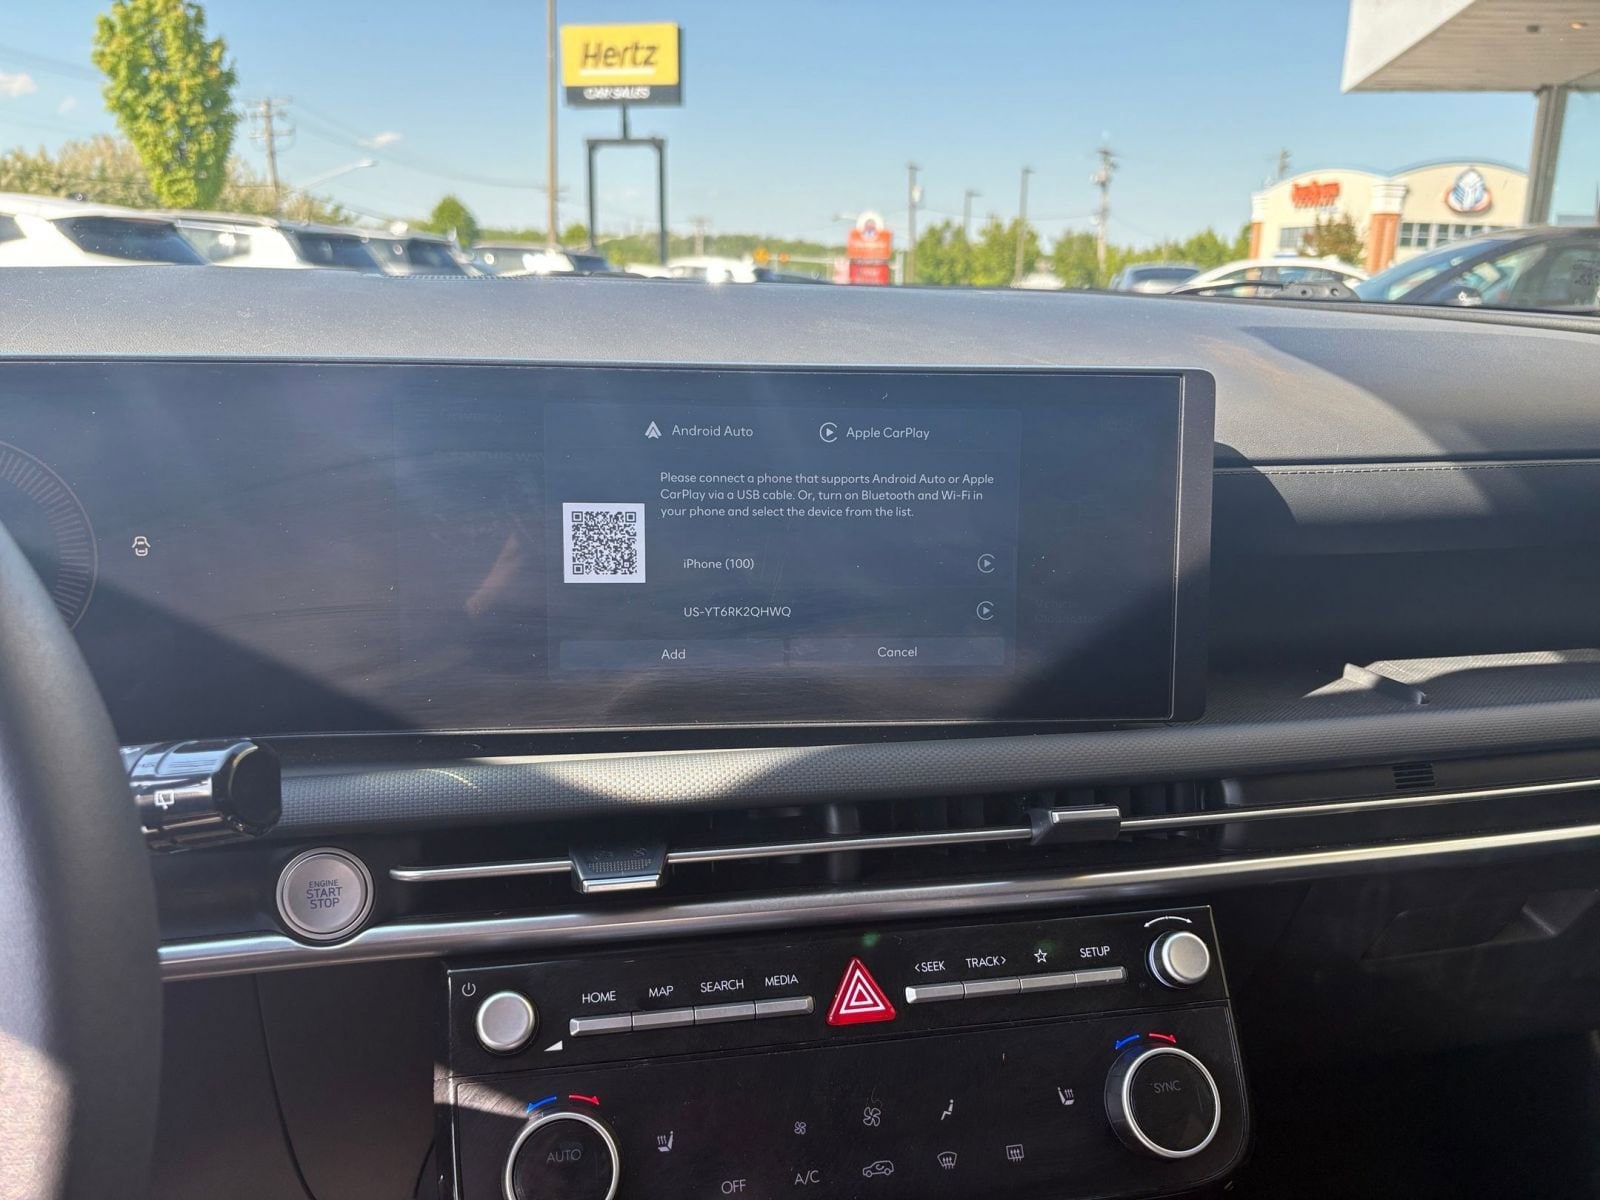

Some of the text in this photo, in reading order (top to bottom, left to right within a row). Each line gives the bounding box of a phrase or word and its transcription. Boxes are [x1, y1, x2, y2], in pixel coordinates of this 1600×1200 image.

[580, 41, 658, 68] Hertz
[671, 424, 753, 437] Android Auto
[846, 427, 931, 440] Apple CarPlay
[660, 472, 994, 486] Please connect a phone that supports Android Auto or Apple
[660, 489, 983, 501] CarPlay via a USB cable. Or, turn on Bluetooth and Wi-Fi in
[660, 506, 914, 518] your phone and select the device from the list.
[683, 558, 754, 570] iPhone (100)
[684, 606, 792, 617] US-YT6RK2QHWQ
[661, 649, 686, 660] Add
[877, 646, 918, 657] Cancel
[308, 880, 339, 888] ENGINE
[306, 886, 343, 899] START
[310, 897, 340, 910] STOP
[1079, 945, 1110, 958] SETUP
[700, 979, 744, 993] SEARCH
[765, 974, 799, 987] MEDIA
[581, 990, 617, 1004] HOME
[648, 985, 674, 998] MAP
[1153, 1080, 1182, 1094] SYNC
[546, 1148, 582, 1163] AUTO
[794, 1169, 820, 1185] A/C
[721, 1178, 746, 1194] OFF
